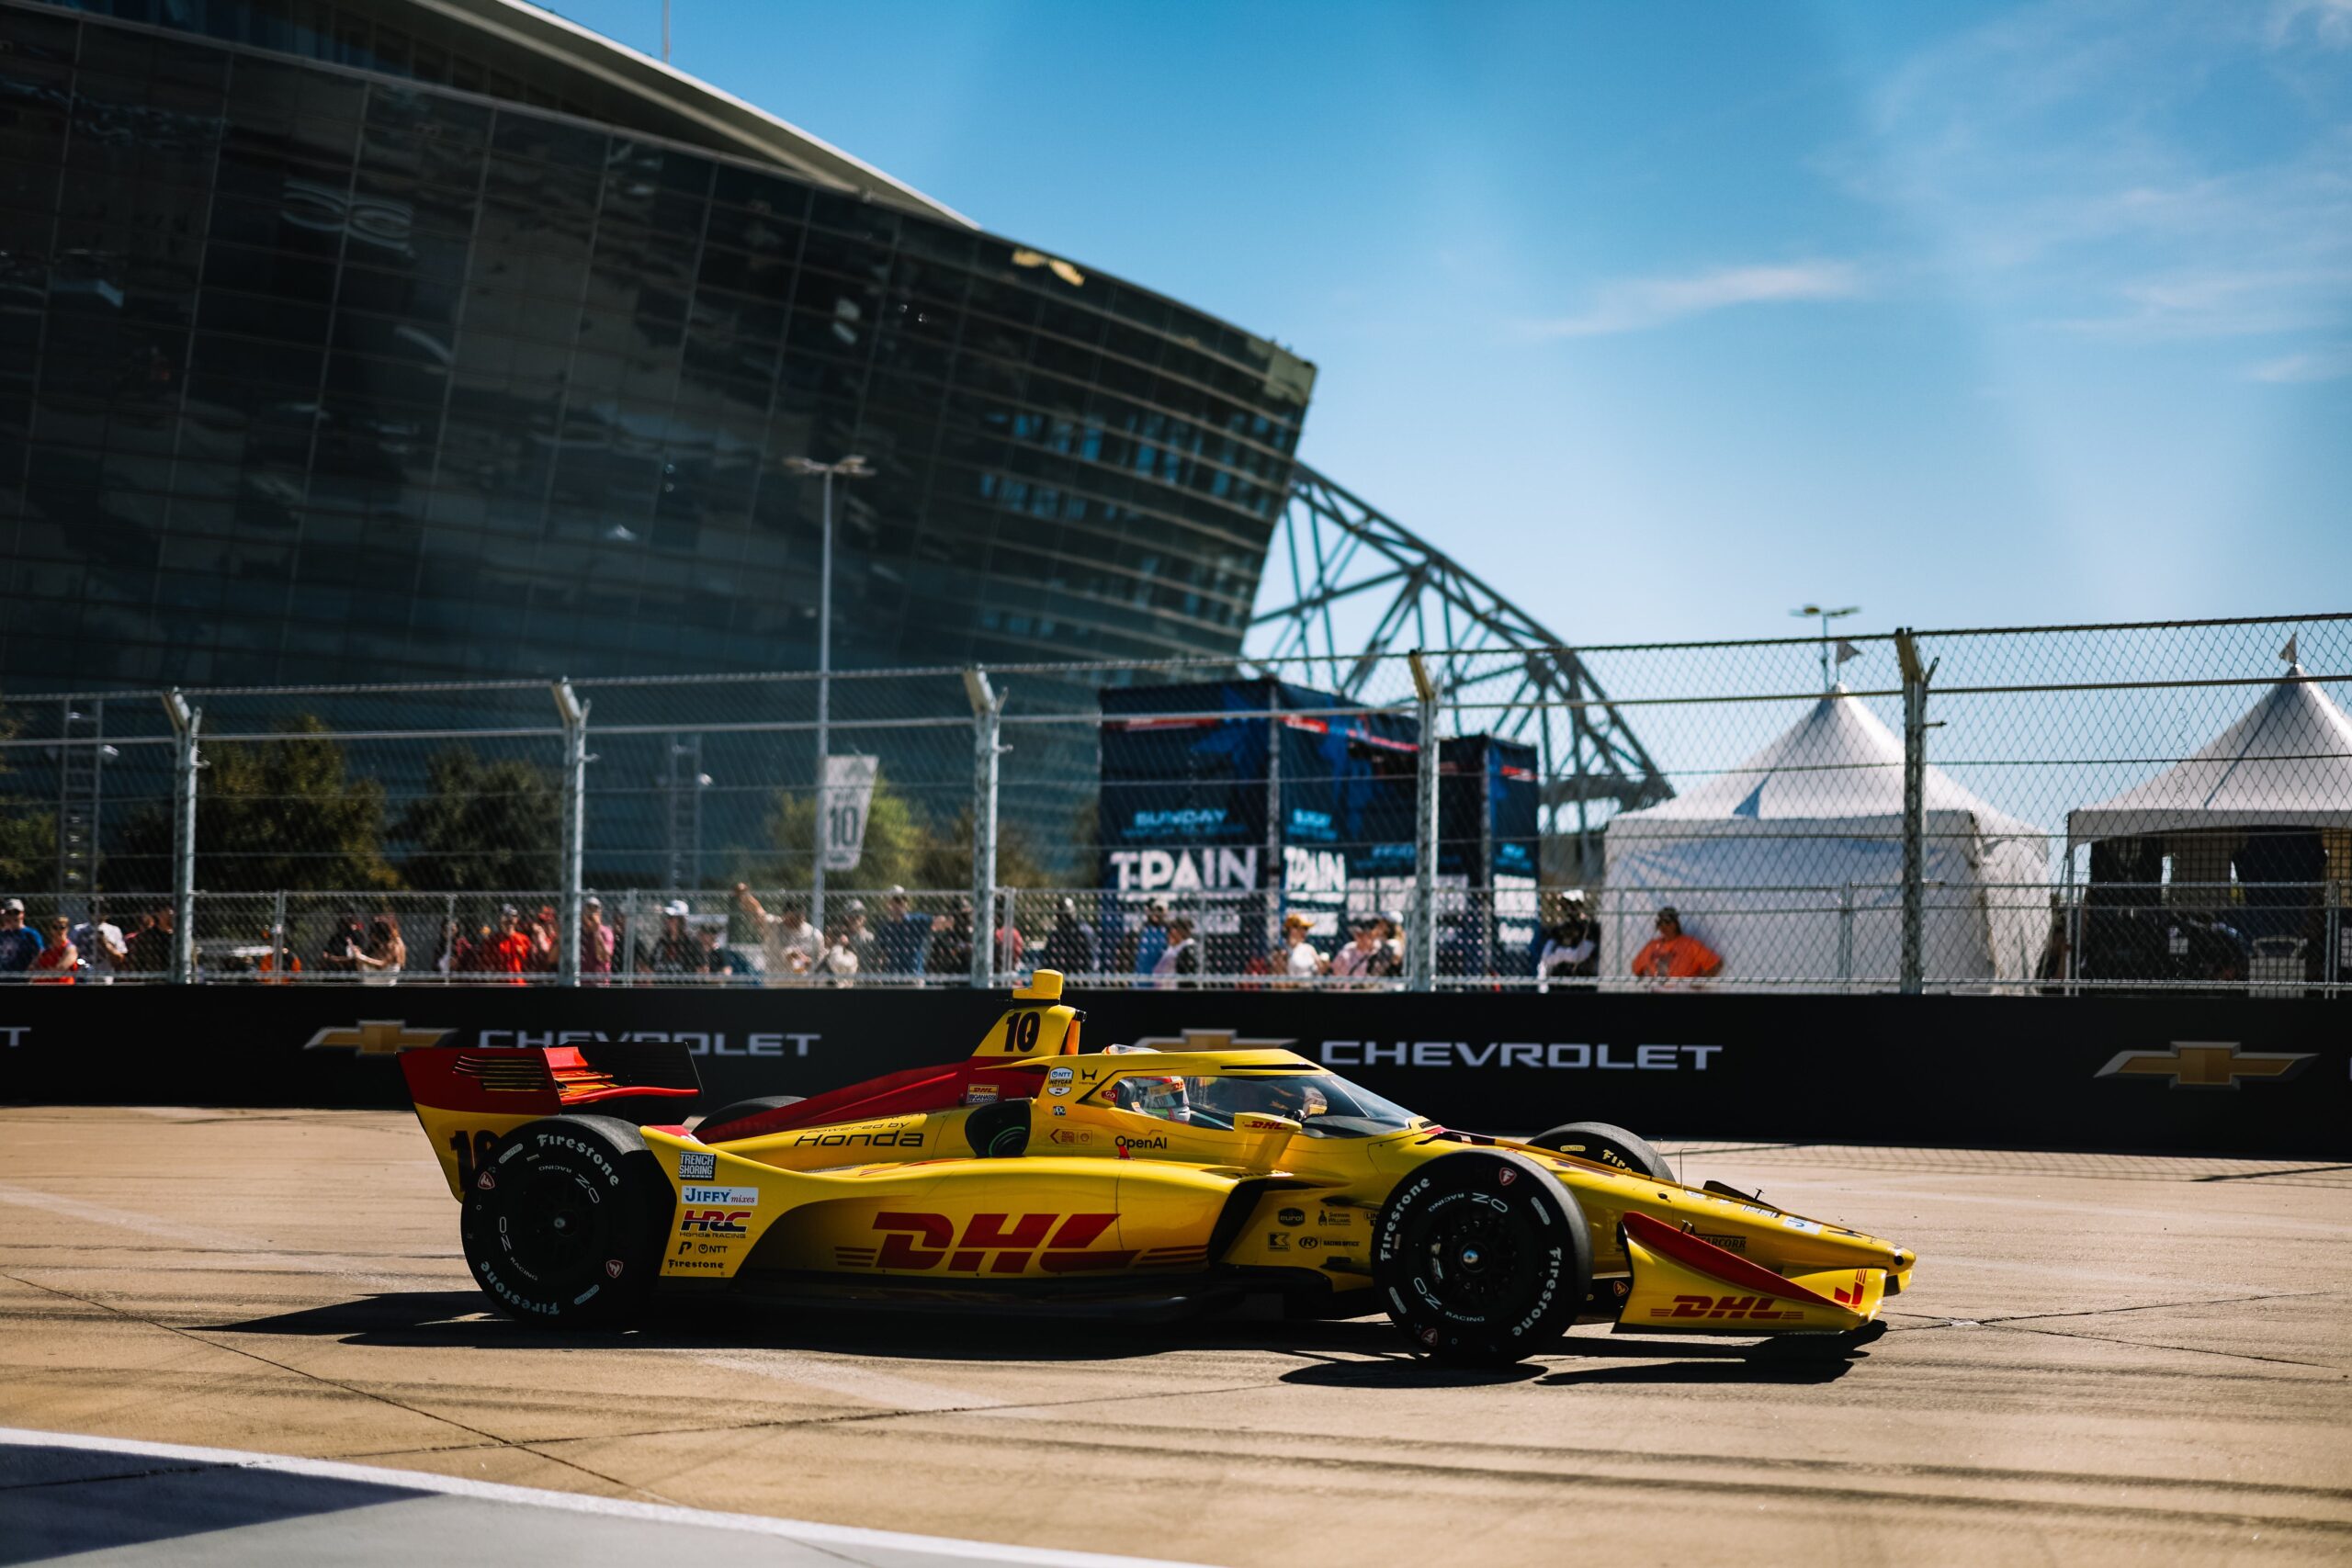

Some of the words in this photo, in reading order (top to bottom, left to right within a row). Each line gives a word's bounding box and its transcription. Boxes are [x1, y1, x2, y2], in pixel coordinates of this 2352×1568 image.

[1004, 1011, 1041, 1053] 10
[1321, 1041, 1723, 1070] CHEVROLET
[807, 1122, 885, 1134] Powered
[1250, 1121, 1285, 1130] DHL
[794, 1130, 924, 1147] Honda
[1114, 1135, 1168, 1150] OpenAI
[537, 1134, 619, 1186] Firestone
[680, 1154, 714, 1166] TRENCH
[538, 1165, 571, 1174] RACING
[679, 1165, 713, 1175] SHORING
[730, 1195, 755, 1203] mixes
[1428, 1193, 1464, 1213] RACING
[681, 1210, 752, 1234] HRC
[1380, 1177, 1430, 1261] Firestone
[709, 1246, 728, 1254] NTT
[872, 1212, 1141, 1273] DHL
[510, 1257, 538, 1281] RACING
[668, 1258, 724, 1269] Firestone
[481, 1261, 560, 1315] Firestone
[1512, 1247, 1562, 1337] Firestone
[1671, 1294, 1783, 1319] DHL
[1444, 1311, 1485, 1323] RACING
